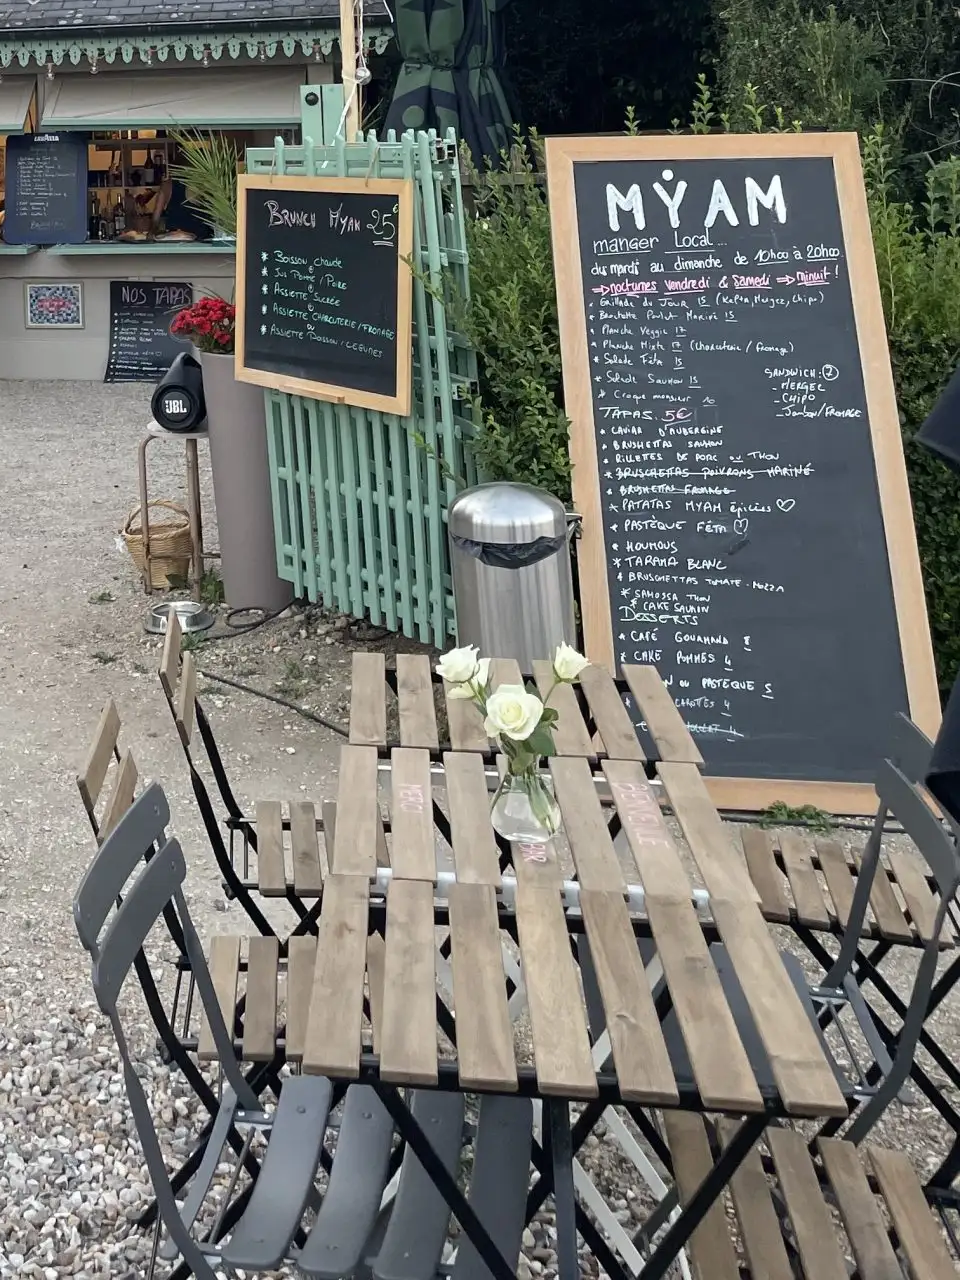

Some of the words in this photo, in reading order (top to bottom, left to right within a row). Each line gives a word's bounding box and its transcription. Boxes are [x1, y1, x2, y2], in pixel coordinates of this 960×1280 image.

[591, 263, 607, 276] du
[610, 260, 640, 277] mardi
[650, 263, 665, 273] au
[674, 254, 722, 271] dimanche
[734, 251, 749, 265] de
[793, 246, 803, 260] à
[719, 276, 728, 289] &
[121, 285, 147, 305] NOS
[165, 400, 187, 414] JBL
[622, 499, 672, 511] PATATAS
[626, 540, 678, 554] HOUMOUS
